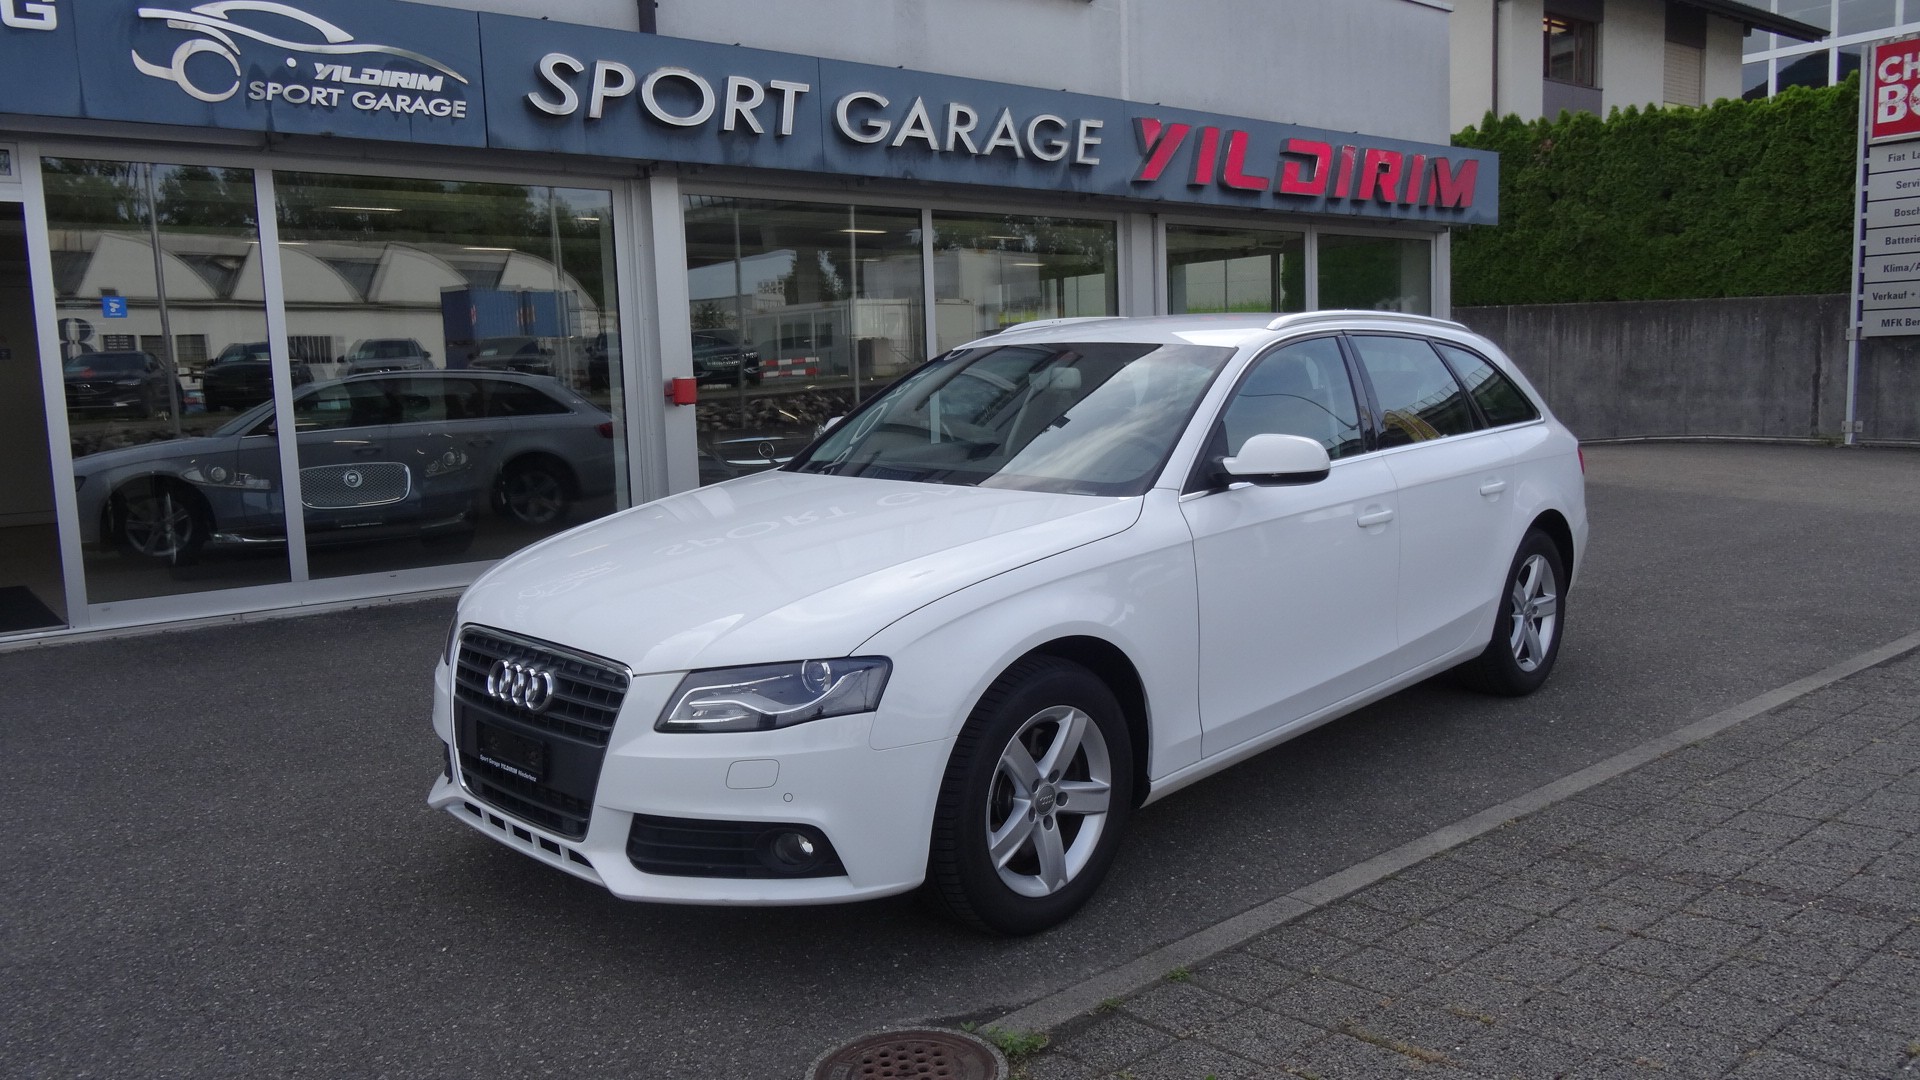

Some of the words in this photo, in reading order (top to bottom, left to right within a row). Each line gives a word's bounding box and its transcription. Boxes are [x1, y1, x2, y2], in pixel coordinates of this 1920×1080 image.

[314, 62, 443, 92] YILDIRIM
[248, 81, 344, 107] SPORT
[352, 91, 466, 118] GARAGE
[527, 52, 810, 137] SPORT
[832, 91, 1104, 166] GARAGE
[1131, 117, 1479, 209] YILDIRIM
[1888, 153, 1906, 163] Fiat
[1896, 179, 1920, 190] Servi
[1872, 290, 1907, 301] Verkauf
[1881, 318, 1902, 328] MFK
